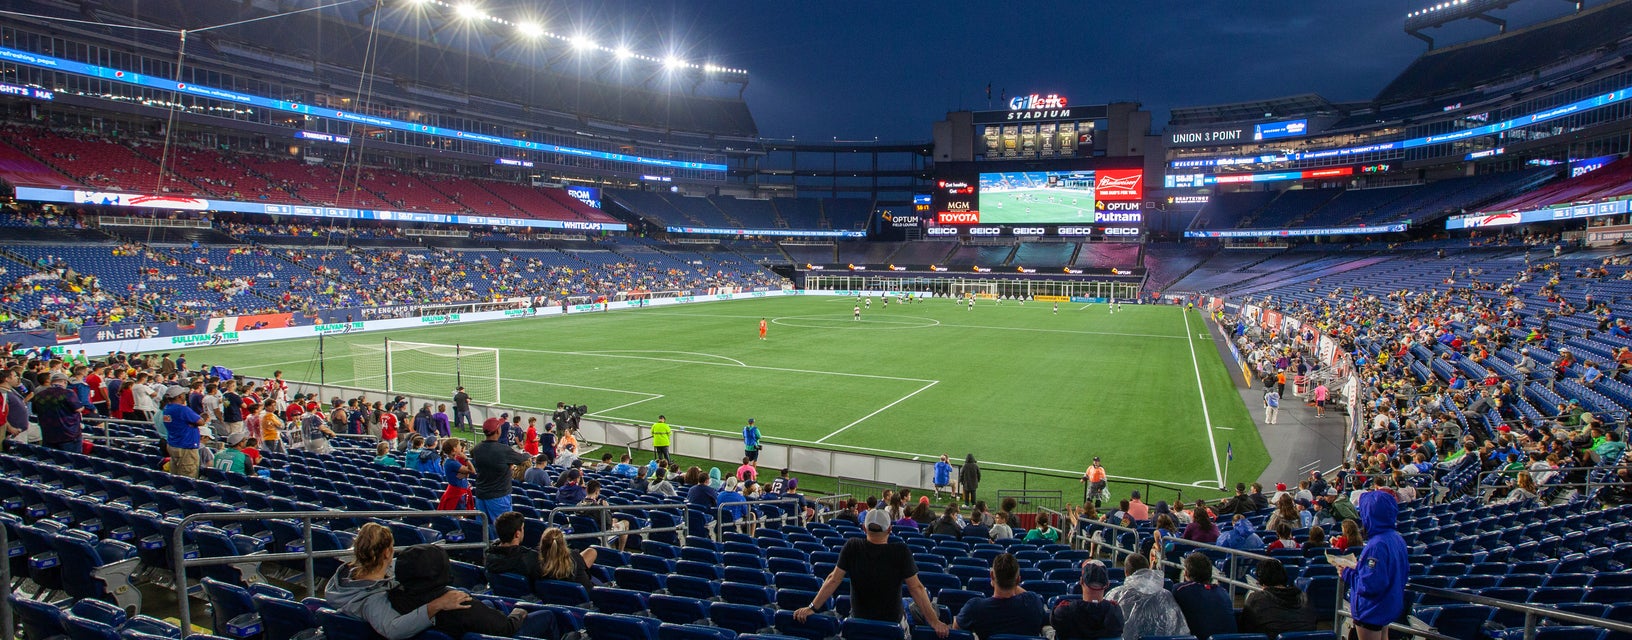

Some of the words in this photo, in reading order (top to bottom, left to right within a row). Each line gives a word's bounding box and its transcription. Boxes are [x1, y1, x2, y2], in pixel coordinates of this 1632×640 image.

[1009, 94, 1068, 110] Gillette
[1007, 110, 1070, 120] STADIUM
[1173, 132, 1202, 143] UNION
[1213, 129, 1242, 141] POINT
[1100, 179, 1136, 187] Budweiser
[568, 189, 590, 199] FROM
[947, 201, 970, 209] MGM
[940, 213, 978, 222] TOYOTA
[1095, 212, 1141, 222] Putnam
[564, 221, 601, 230] WHITECAPS
[970, 227, 1000, 235] GEICO
[1013, 227, 1045, 235] GEICO
[1058, 227, 1091, 235] GEICO
[1105, 227, 1139, 235] GEICO
[422, 315, 445, 323] SULLIVAN
[314, 323, 345, 332] SULLIVAN
[352, 321, 365, 329] TIRE
[171, 334, 211, 344] SULLIVAN
[222, 331, 239, 339] TIRE
[772, 481, 783, 494] 12
